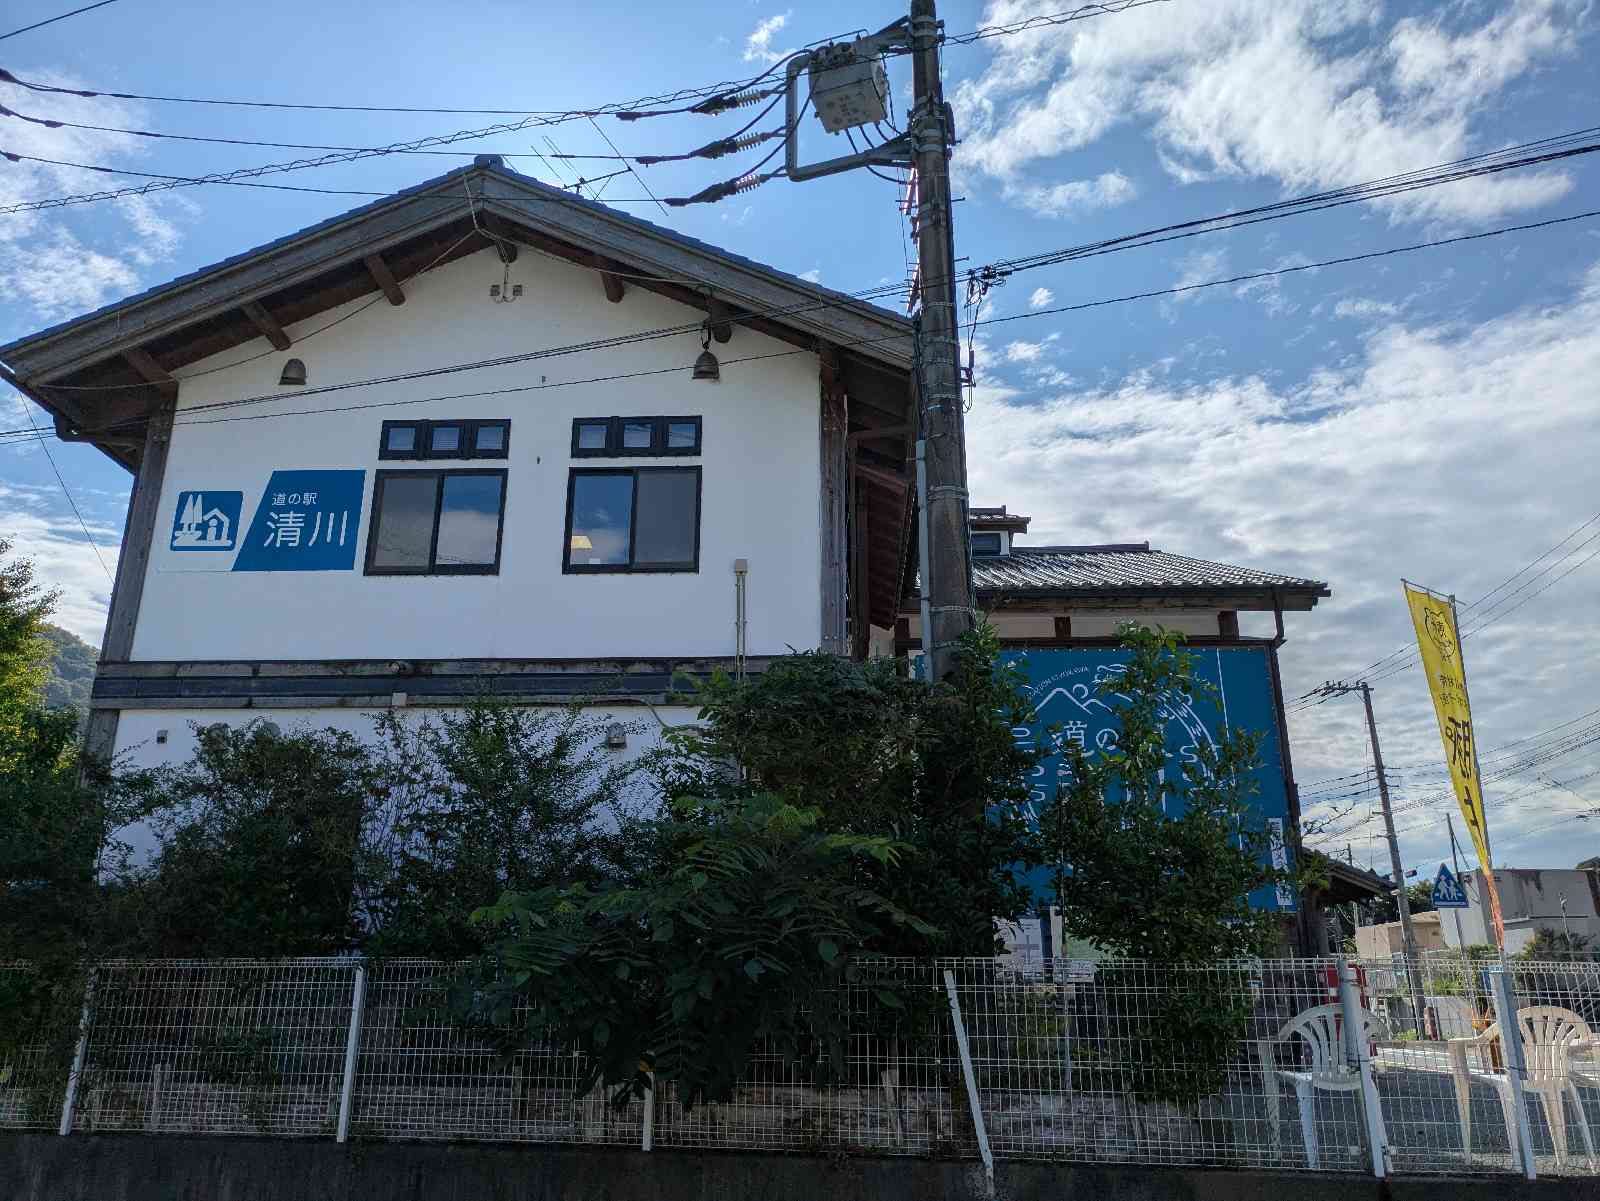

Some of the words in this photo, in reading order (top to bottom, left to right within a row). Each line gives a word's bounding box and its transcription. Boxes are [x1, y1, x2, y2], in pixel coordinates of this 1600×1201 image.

[271, 492, 318, 506] 道の駅
[263, 510, 348, 548] 清川
